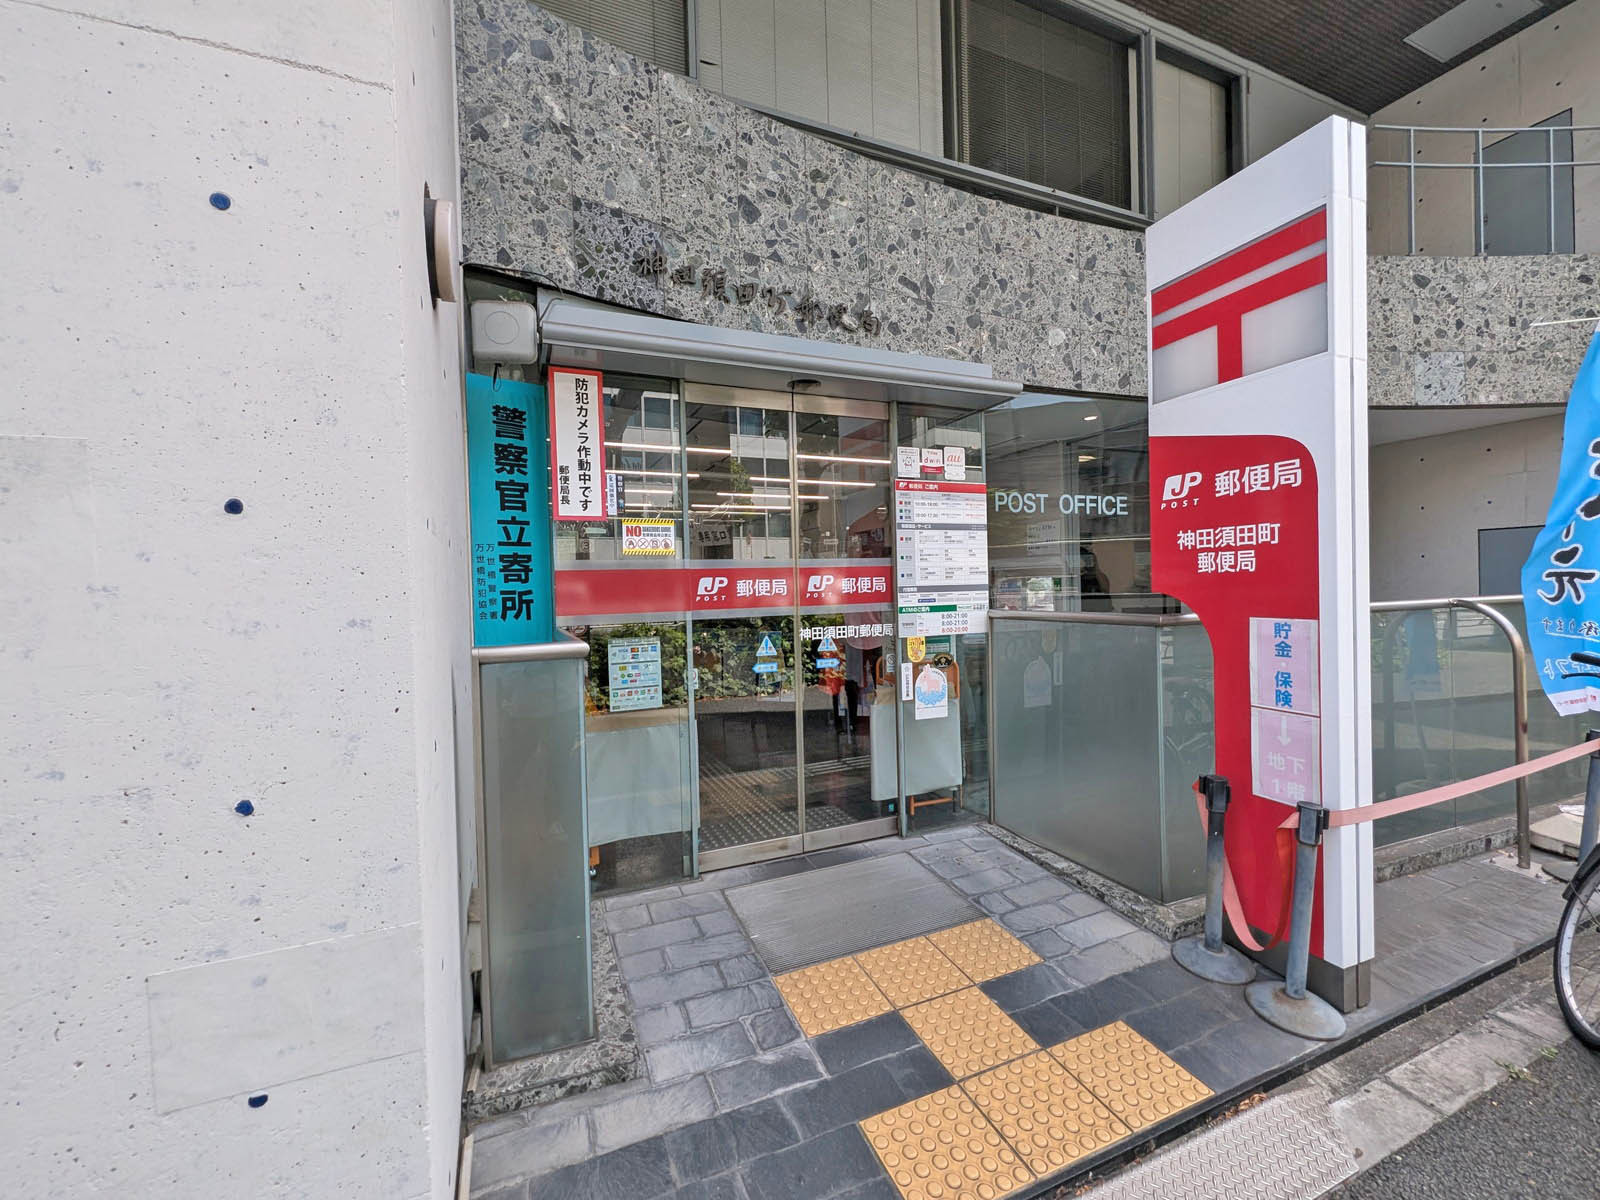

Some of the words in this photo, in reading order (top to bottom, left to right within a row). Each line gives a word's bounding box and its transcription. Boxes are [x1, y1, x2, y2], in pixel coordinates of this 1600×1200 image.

[575, 378, 592, 512] 防犯カメラ作動中です
[559, 465, 570, 505] 郵便局長
[1215, 458, 1302, 498] 郵便局
[491, 404, 534, 622] 警察官立寄所
[994, 492, 1049, 514] POST
[1059, 494, 1129, 516] OFFICE
[1160, 498, 1200, 511] POST
[625, 525, 642, 537] NO
[1177, 523, 1281, 550] 神田須田町
[1197, 550, 1256, 574] 郵便局
[475, 543, 488, 620] 万世橋防犯協会
[736, 578, 788, 597] 郵便局
[841, 576, 886, 594] 郵便局
[799, 623, 894, 641] 神田須田町郵便局
[1273, 622, 1293, 708] 貯金・保険
[1264, 752, 1305, 775] 地下
